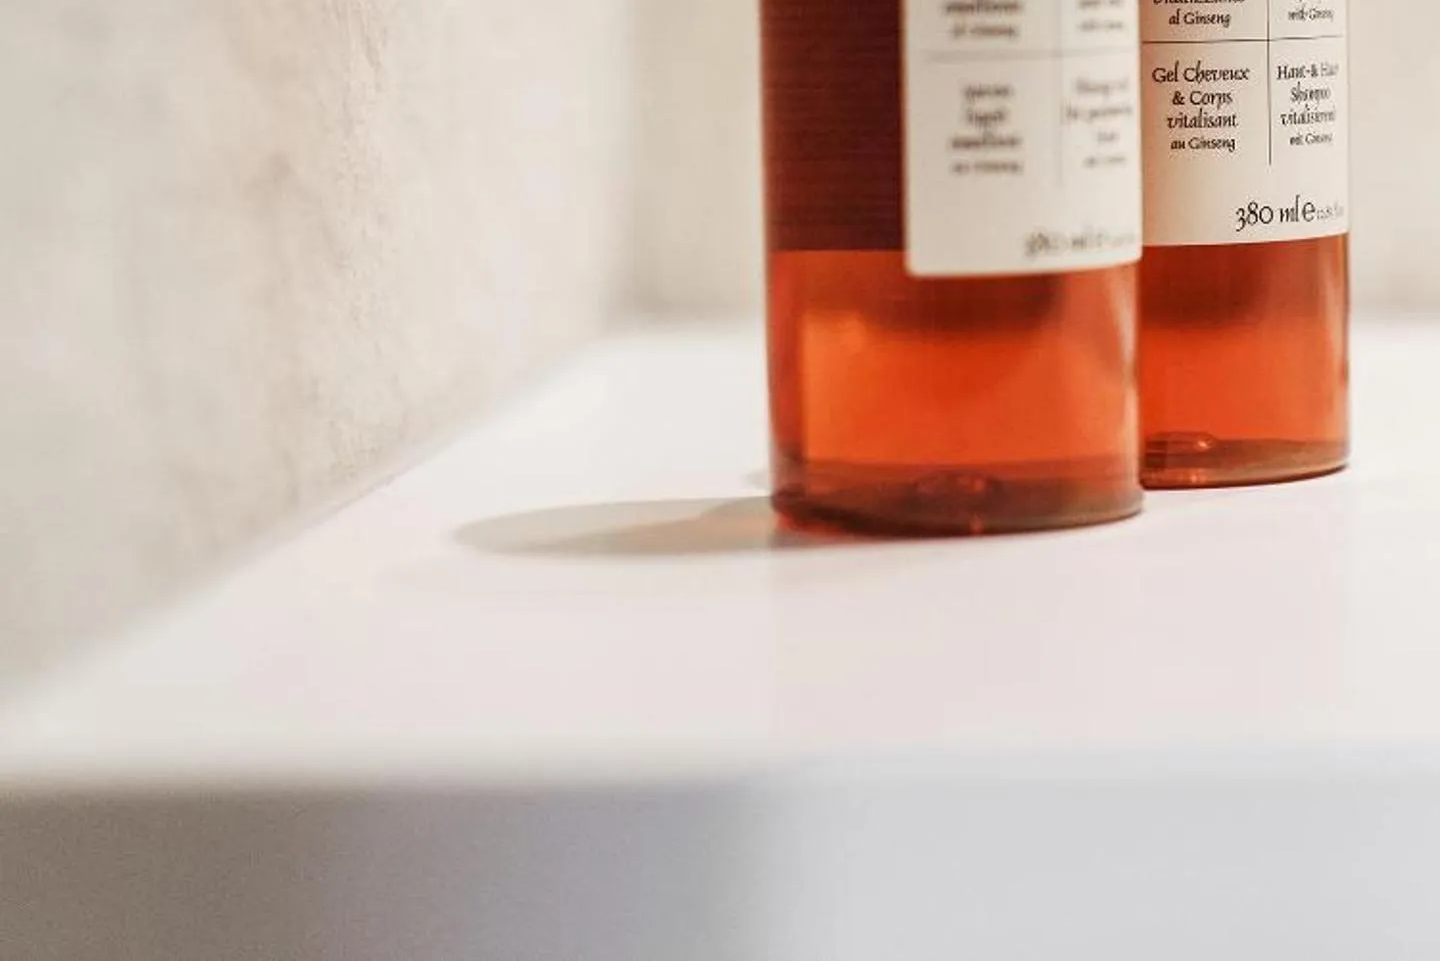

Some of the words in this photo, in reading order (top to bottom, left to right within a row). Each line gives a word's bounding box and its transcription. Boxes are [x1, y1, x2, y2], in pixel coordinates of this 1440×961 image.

[1168, 8, 1180, 25] al
[1184, 11, 1231, 27] Ginseng
[1152, 60, 1180, 82] Gel
[1184, 60, 1250, 83] Cheveux
[1172, 90, 1185, 105] &
[1189, 91, 1233, 110] Corps
[1167, 108, 1238, 128] vitalisant
[1171, 140, 1185, 150] au
[1188, 137, 1236, 152] Ginseng
[1236, 201, 1274, 232] 380
